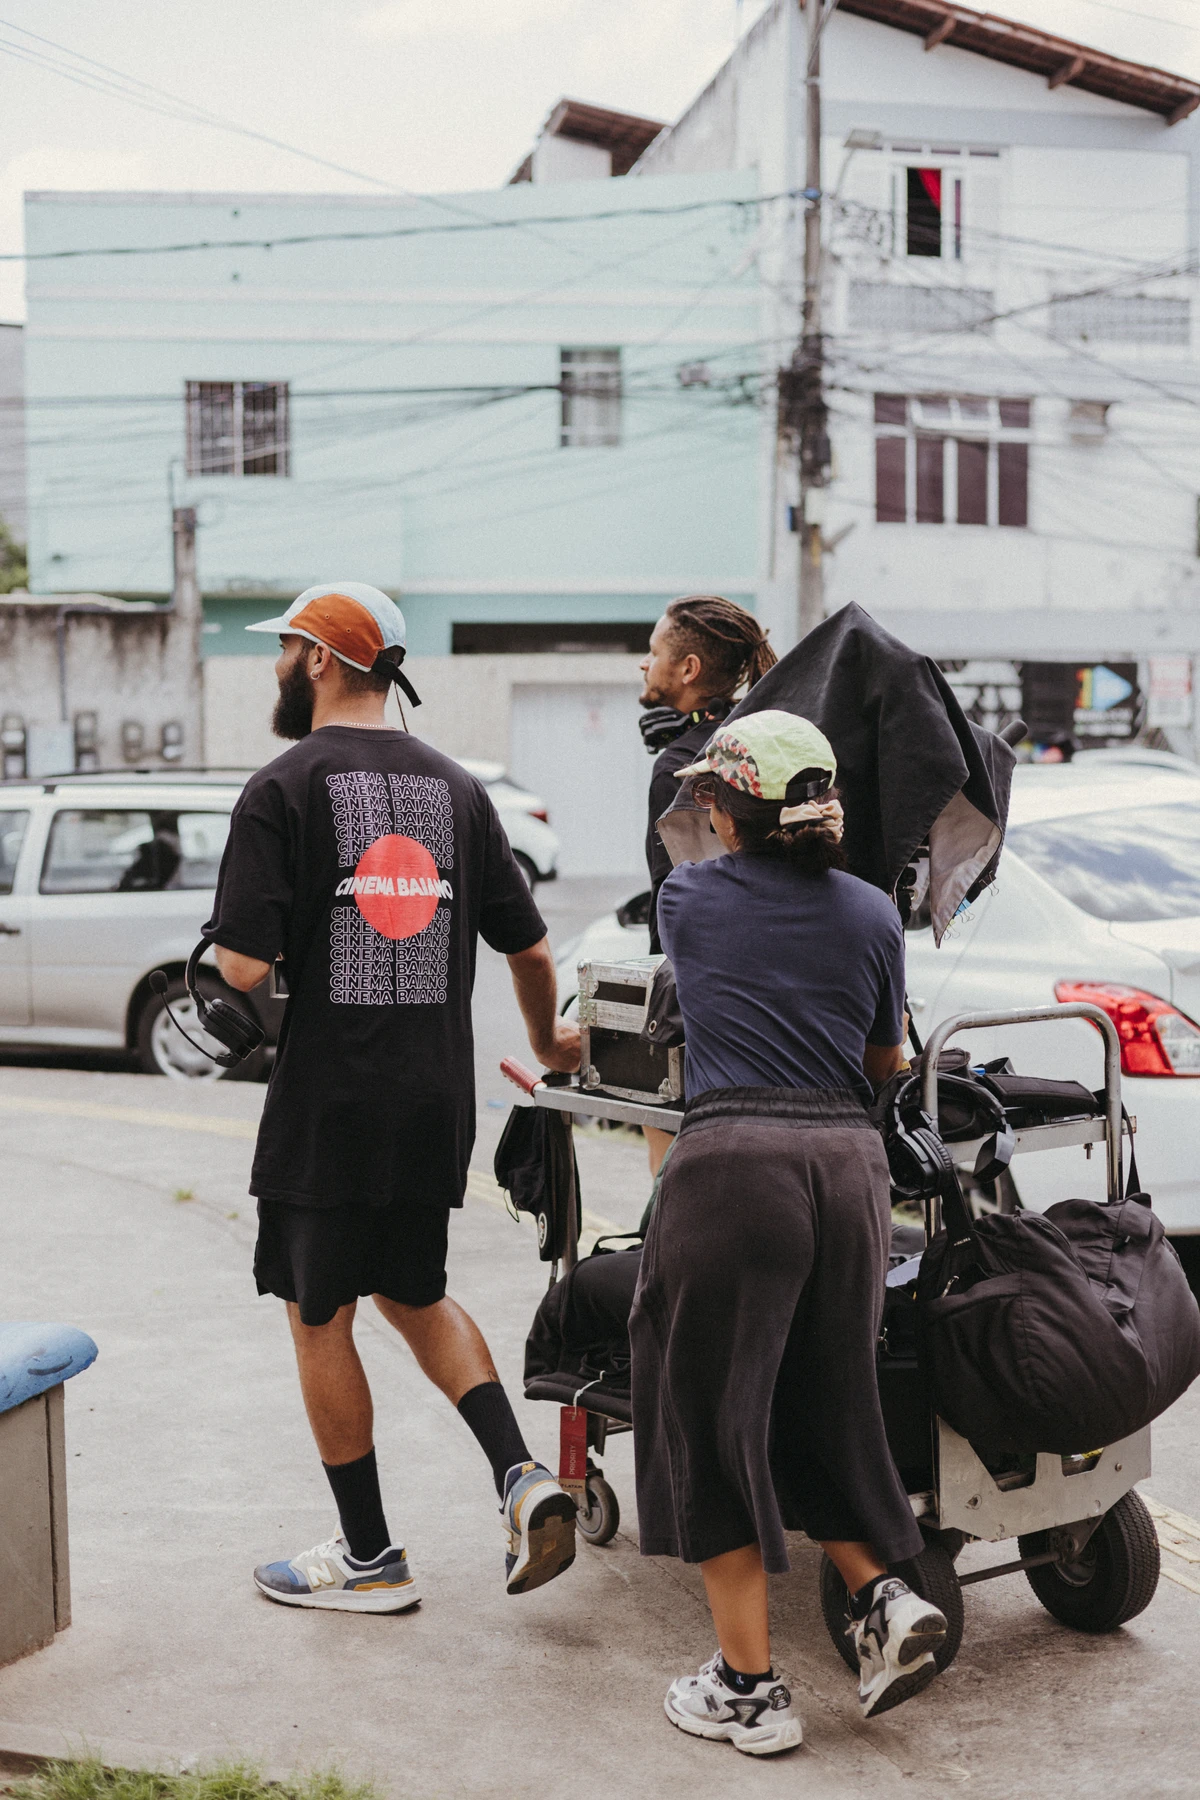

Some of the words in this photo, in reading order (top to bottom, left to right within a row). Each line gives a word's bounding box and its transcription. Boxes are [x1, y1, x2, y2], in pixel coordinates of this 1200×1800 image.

[326, 771, 387, 788] CINEMA
[388, 773, 449, 791] BAIANO
[329, 784, 389, 800] CINEMA
[390, 786, 451, 804] BAIANO
[332, 797, 391, 814] CINEMA
[393, 799, 453, 817] BAIANO
[334, 810, 393, 827] CINEMA
[395, 812, 454, 830] BAIANO
[336, 824, 393, 841] CINEMA
[395, 825, 454, 843] BAIANO
[335, 875, 396, 897] CINEMA
[397, 877, 454, 900] BAIANO
[330, 933, 394, 948] CINEMA
[396, 933, 450, 949] BAIANO
[330, 947, 394, 962] CINEMA
[396, 947, 449, 962] BAIANO
[330, 961, 393, 976] CINEMA
[396, 961, 449, 976] BAIANO
[330, 975, 393, 990] CINEMA
[396, 975, 448, 990] BAIANO
[330, 989, 394, 1005] CINEMA
[396, 989, 447, 1004] BAIANO
[307, 1560, 336, 1588] N
[703, 1694, 720, 1712] N
